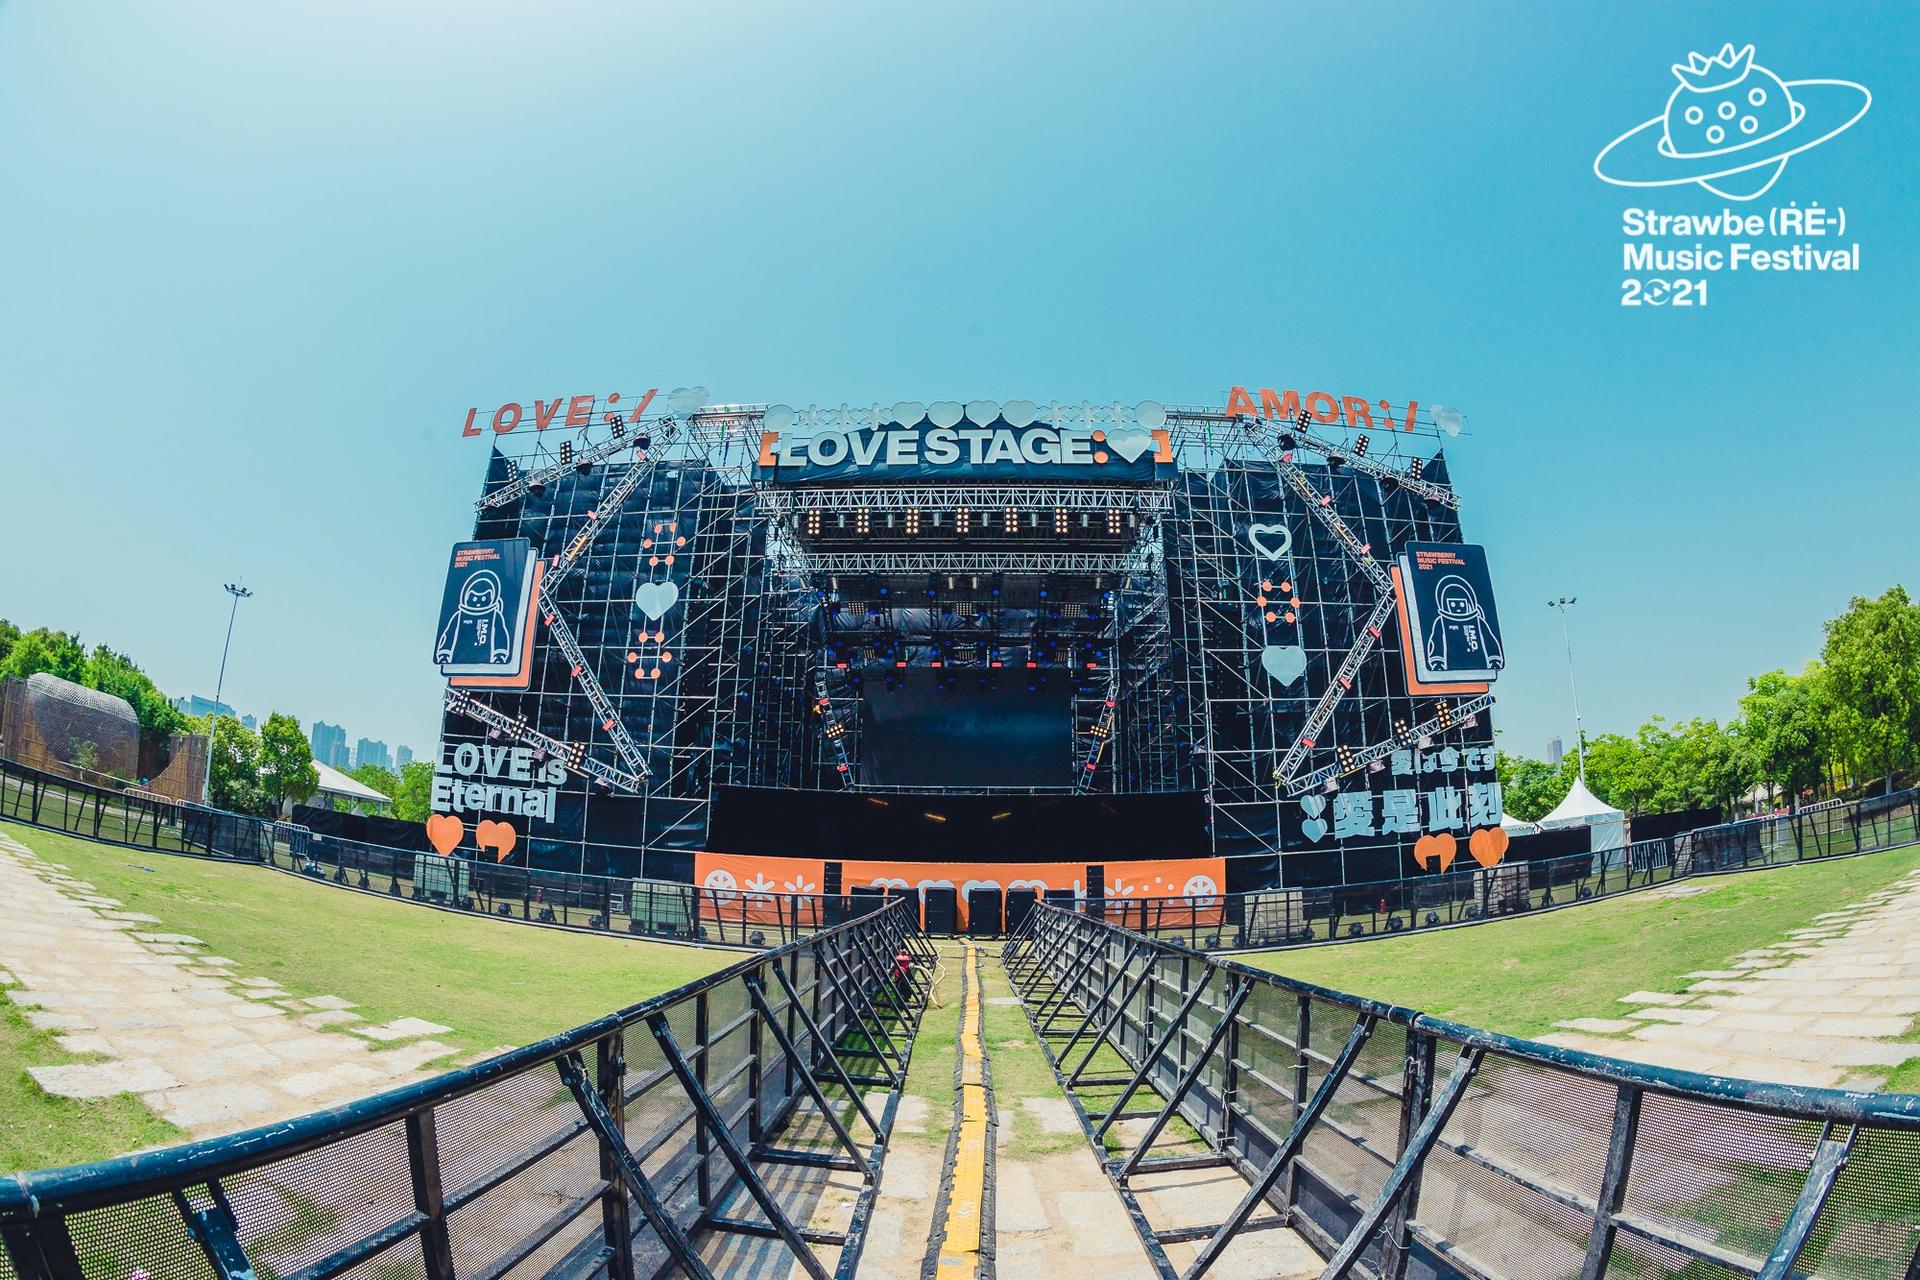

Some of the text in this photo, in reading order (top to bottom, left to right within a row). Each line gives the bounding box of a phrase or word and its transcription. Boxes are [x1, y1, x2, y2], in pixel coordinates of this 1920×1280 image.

[457, 548, 494, 556] STRAWBERRY
[1438, 558, 1465, 566] FESTIVAL
[435, 742, 533, 781] LOVE
[431, 776, 557, 824] Eternal
[1333, 782, 1503, 839] 愛是此刻
